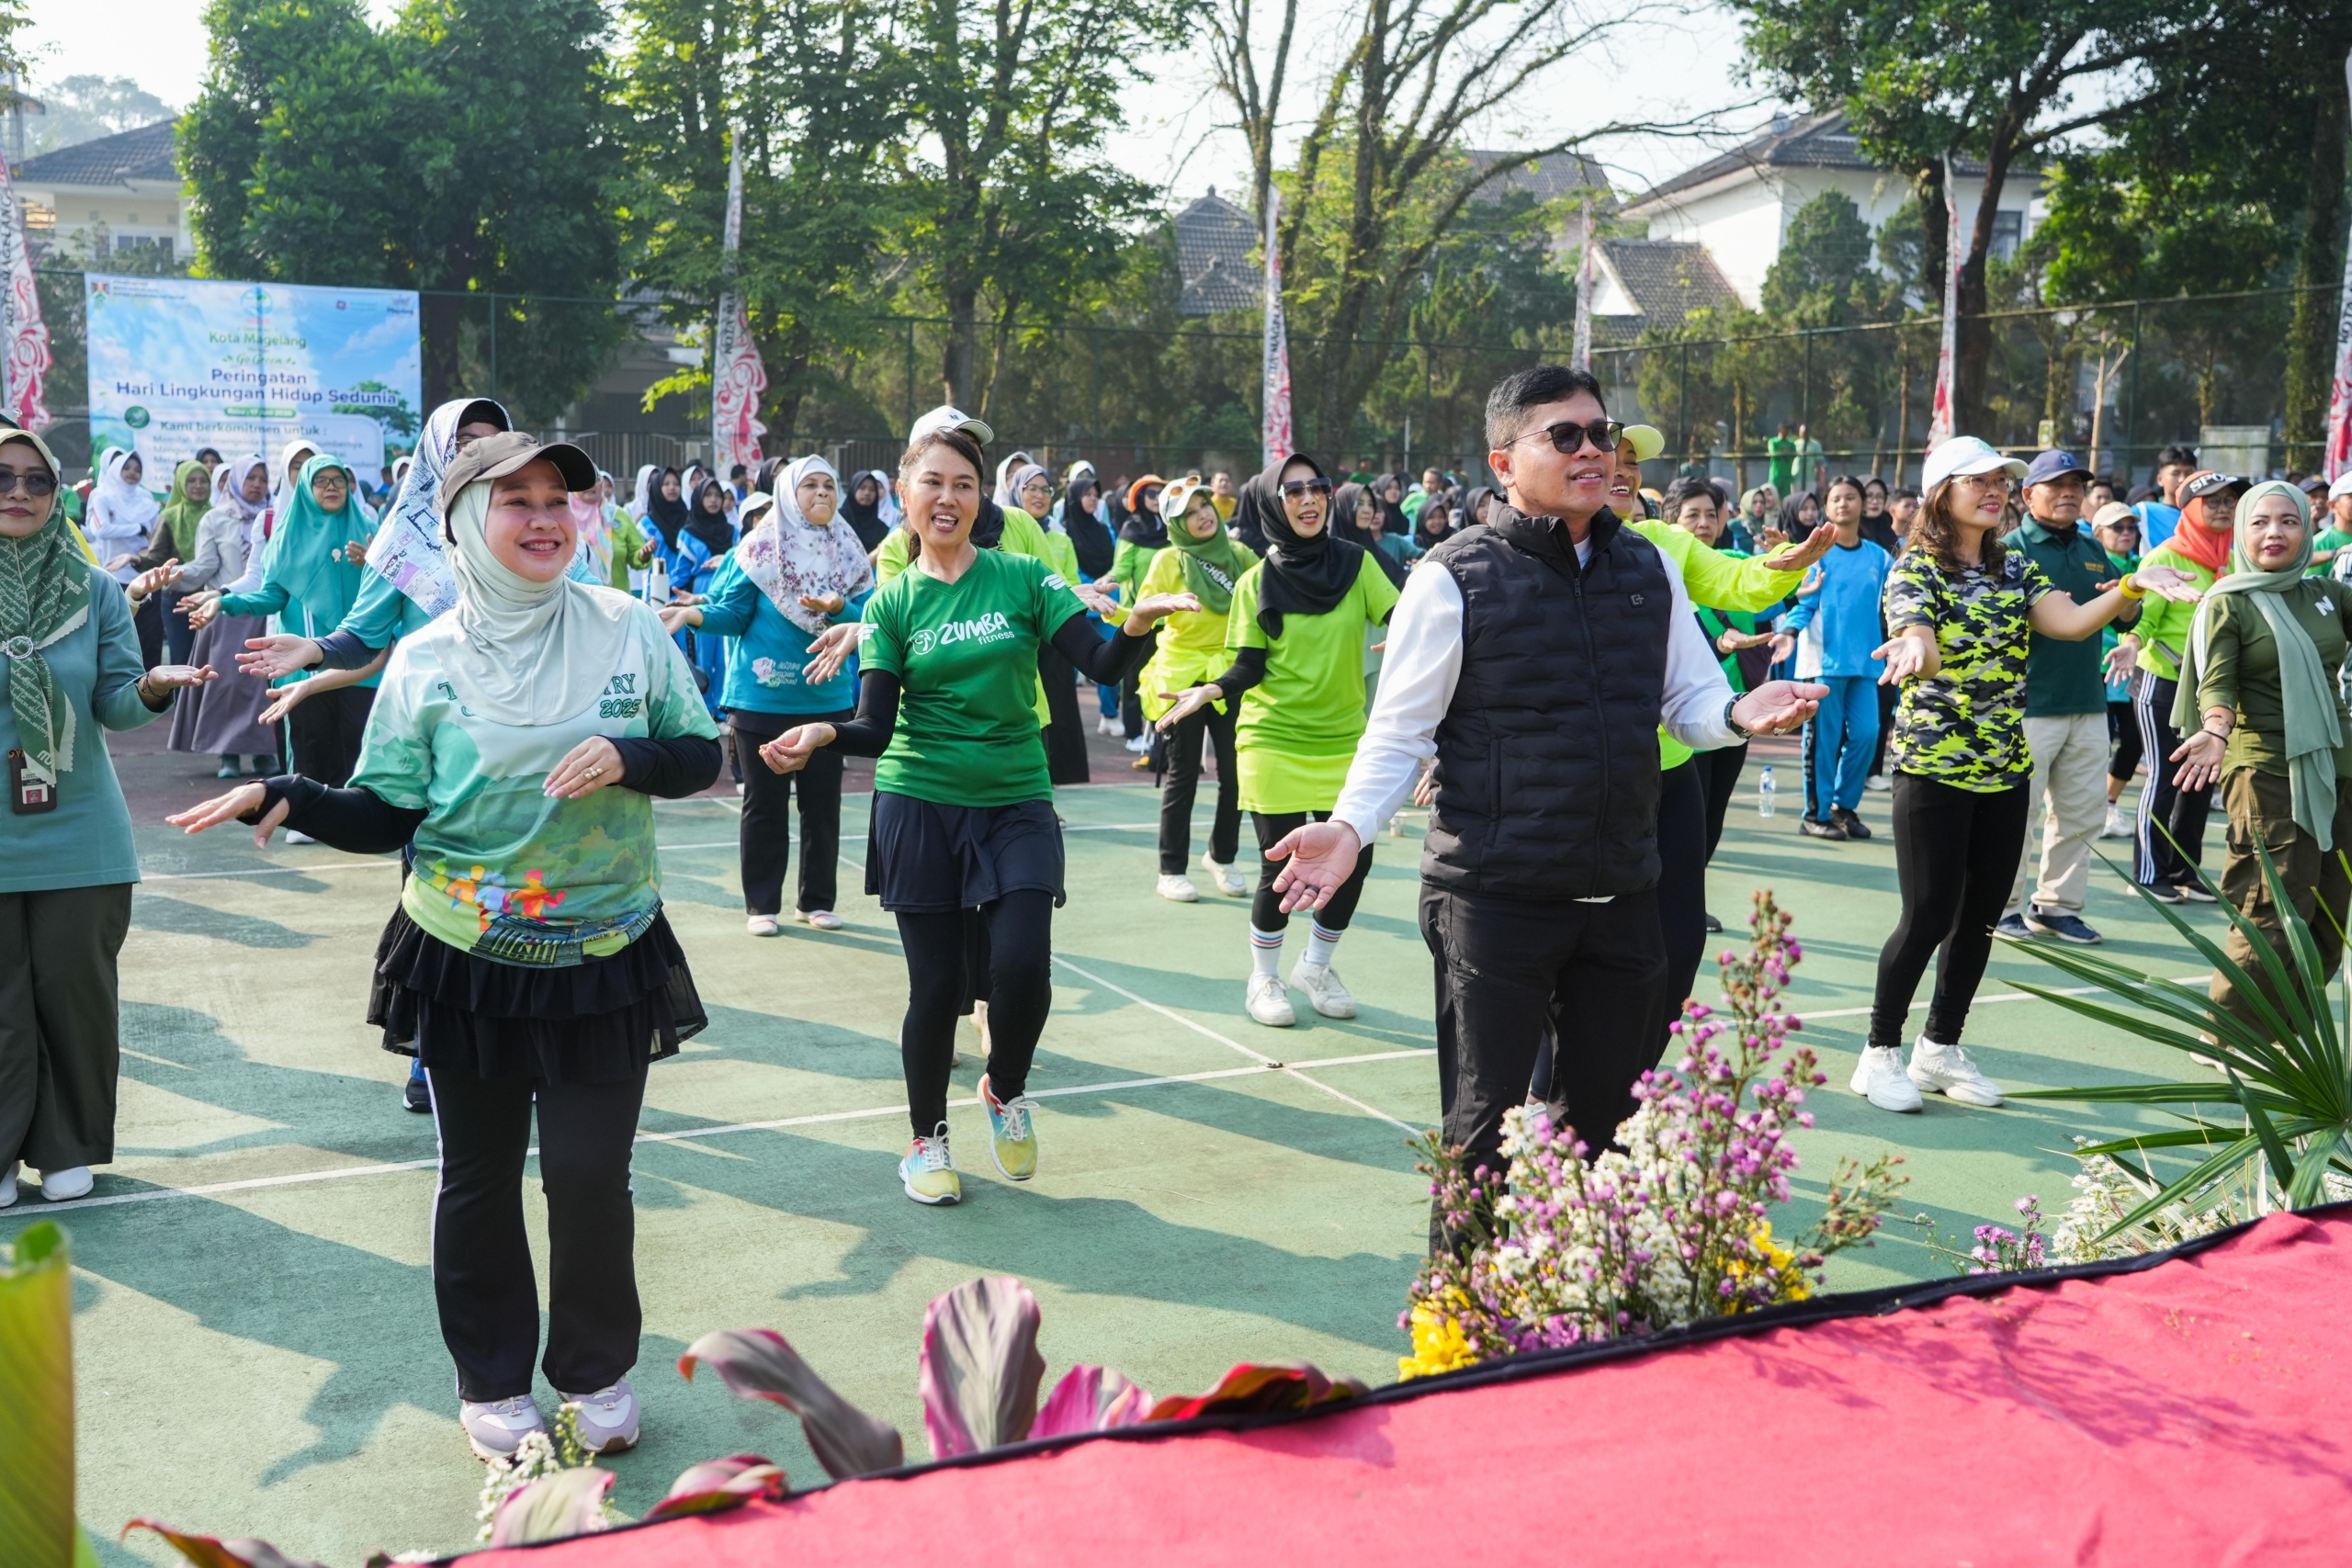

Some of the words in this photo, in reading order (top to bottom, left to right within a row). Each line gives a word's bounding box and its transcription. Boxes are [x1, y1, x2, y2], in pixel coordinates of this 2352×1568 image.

[209, 332, 240, 344] Kota
[244, 333, 307, 349] Magelang
[211, 368, 307, 386] Peringatan
[116, 381, 154, 396] Hari
[160, 383, 265, 402] Lingkungan
[272, 388, 322, 404] Hidup
[328, 389, 397, 405] Sedunia
[161, 422, 192, 432] Kami
[197, 422, 280, 435] berkomitmen
[284, 425, 319, 436] untuk
[2189, 473, 2238, 493] SPO
[937, 612, 1010, 645] ZUMBA
[978, 631, 1015, 645] fitness
[600, 698, 642, 718] 2025
